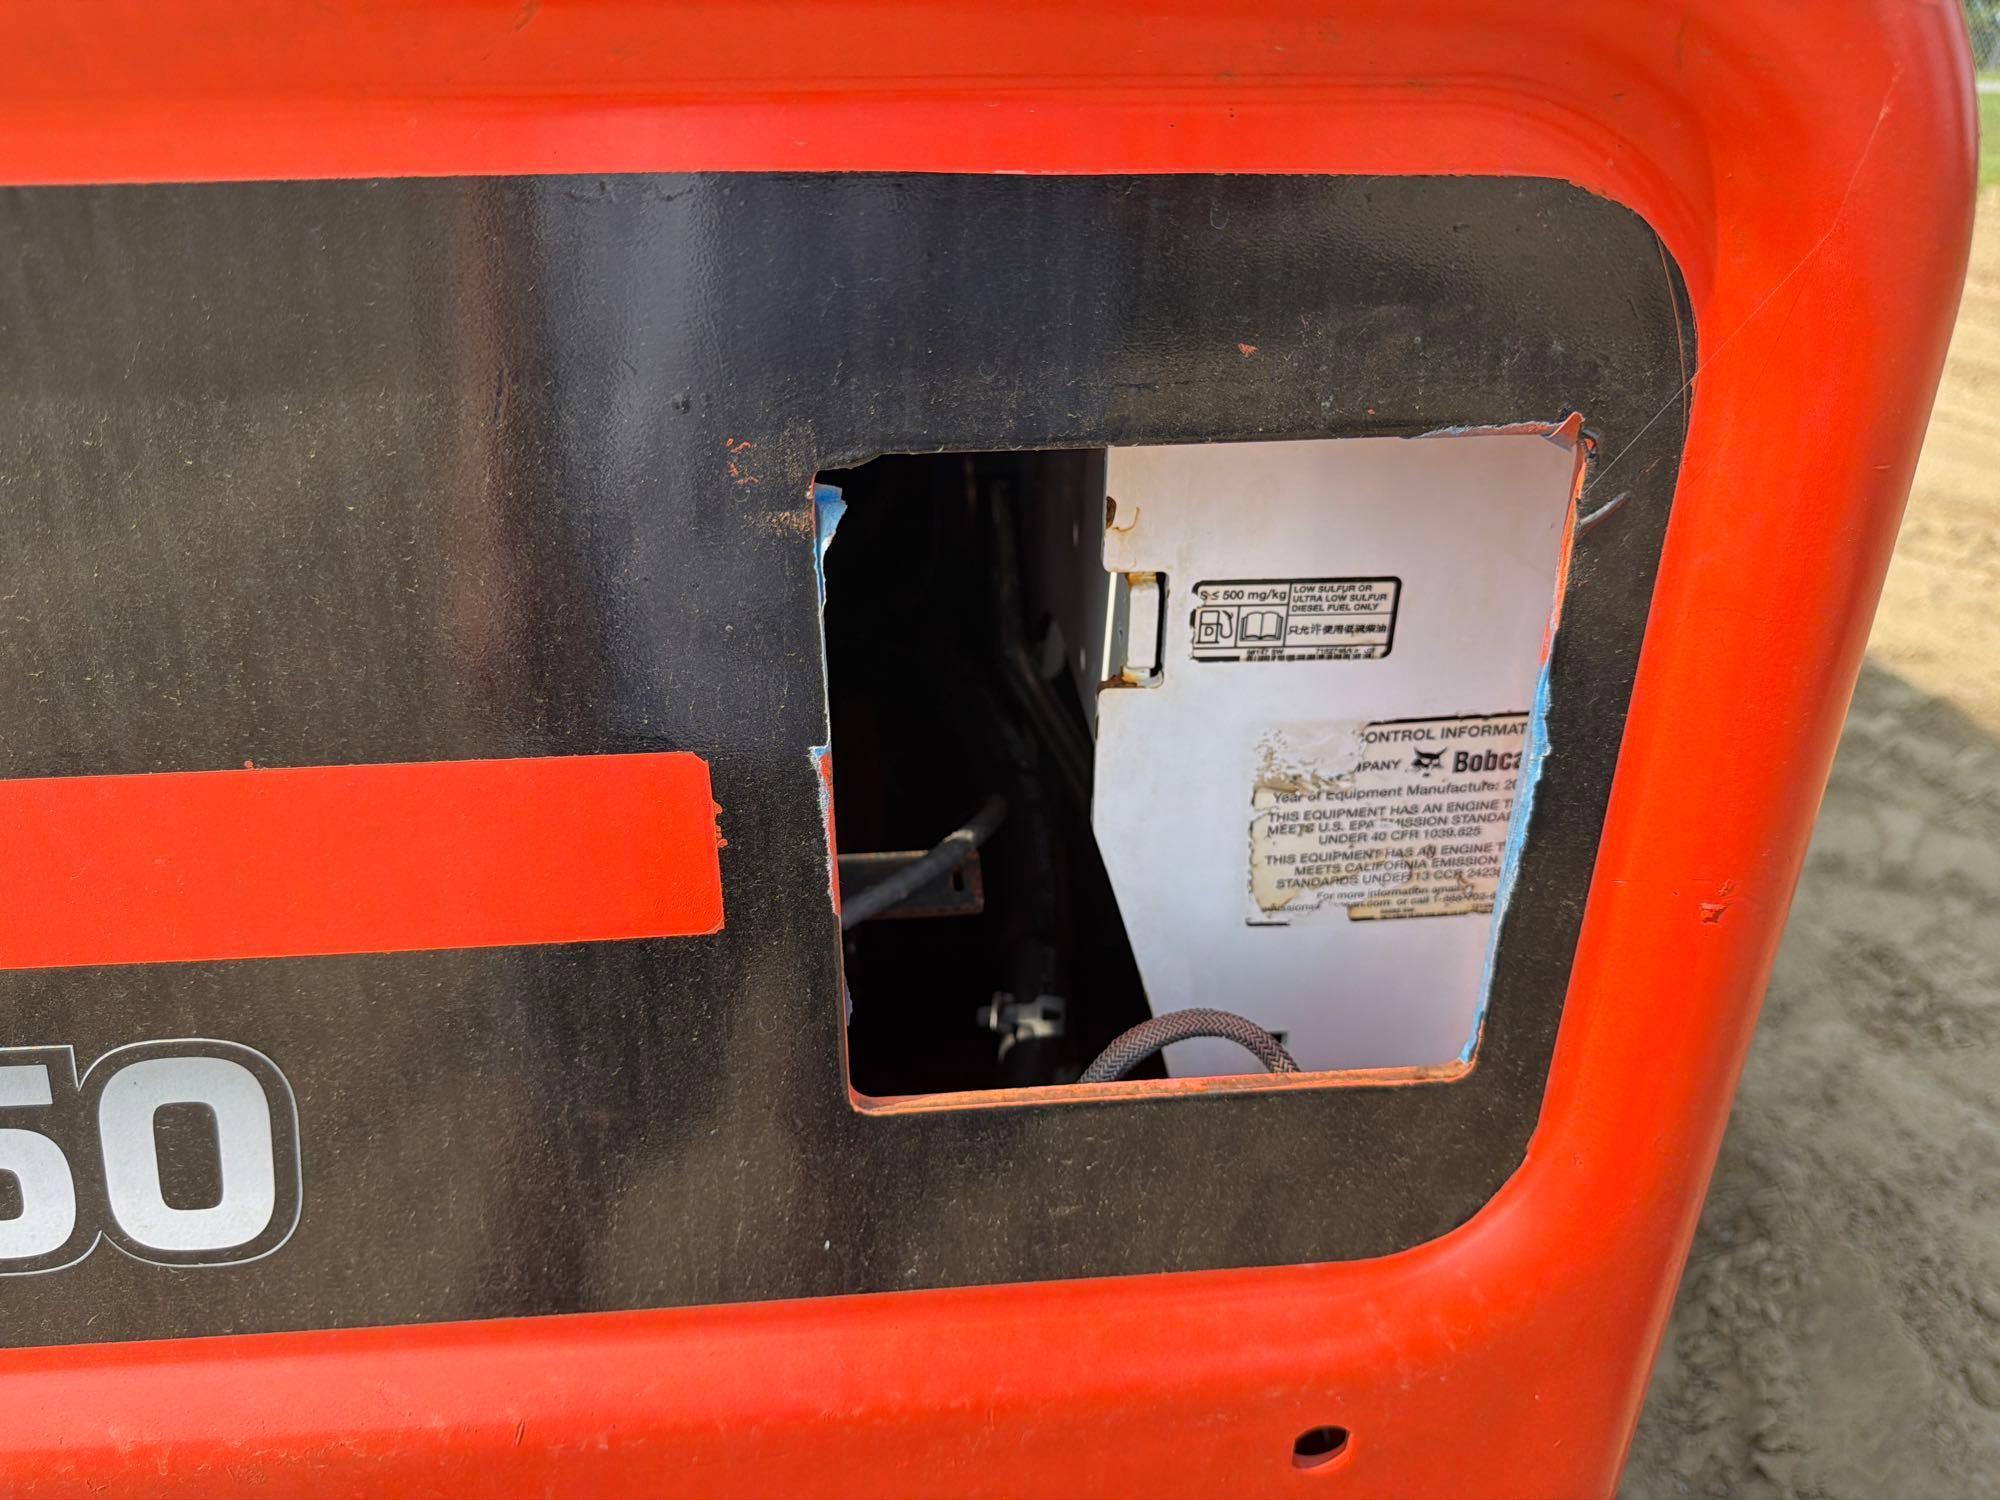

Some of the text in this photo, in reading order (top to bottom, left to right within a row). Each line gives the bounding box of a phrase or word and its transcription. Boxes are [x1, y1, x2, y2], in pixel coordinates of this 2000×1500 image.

[1200, 590, 1208, 600] S
[1222, 590, 1245, 600] 500
[1247, 588, 1287, 602] mg/kg
[1293, 584, 1373, 594] LOW SULFUR OR
[1292, 593, 1388, 603] ULTRA LOW SULFUR
[1291, 602, 1379, 613] DIESEL FUEL ONLY
[1204, 626, 1214, 637] D
[1360, 728, 1435, 744] ONTROL
[1272, 792, 1302, 804] Year
[1325, 787, 1402, 802] Equipment
[1406, 780, 1498, 797] Manufacture:
[1268, 810, 1300, 822] THIS
[1303, 806, 1386, 821] EQUIPMENT
[1389, 803, 1420, 815] HAS
[1422, 803, 1443, 814] AN
[1446, 800, 1499, 813] ENGINE
[1266, 822, 1315, 836] MEETS
[1317, 821, 1344, 832] U.S.
[1348, 819, 1375, 831] EPA
[1318, 832, 1368, 845] UNDER
[1370, 830, 1387, 841] 40
[1390, 828, 1419, 841] CFR
[1265, 853, 1297, 865] THIS
[1299, 848, 1383, 863] EQUIPMENT
[1384, 846, 1414, 858] HAS
[1416, 844, 1437, 857] AN
[1439, 842, 1494, 855] ENGINE
[1294, 855, 1499, 876] MEETS CALIFORNIA EMISSION
[1275, 874, 1360, 890] STANDARDS
[1361, 870, 1412, 885] UNDER
[1415, 869, 1431, 880] 13
